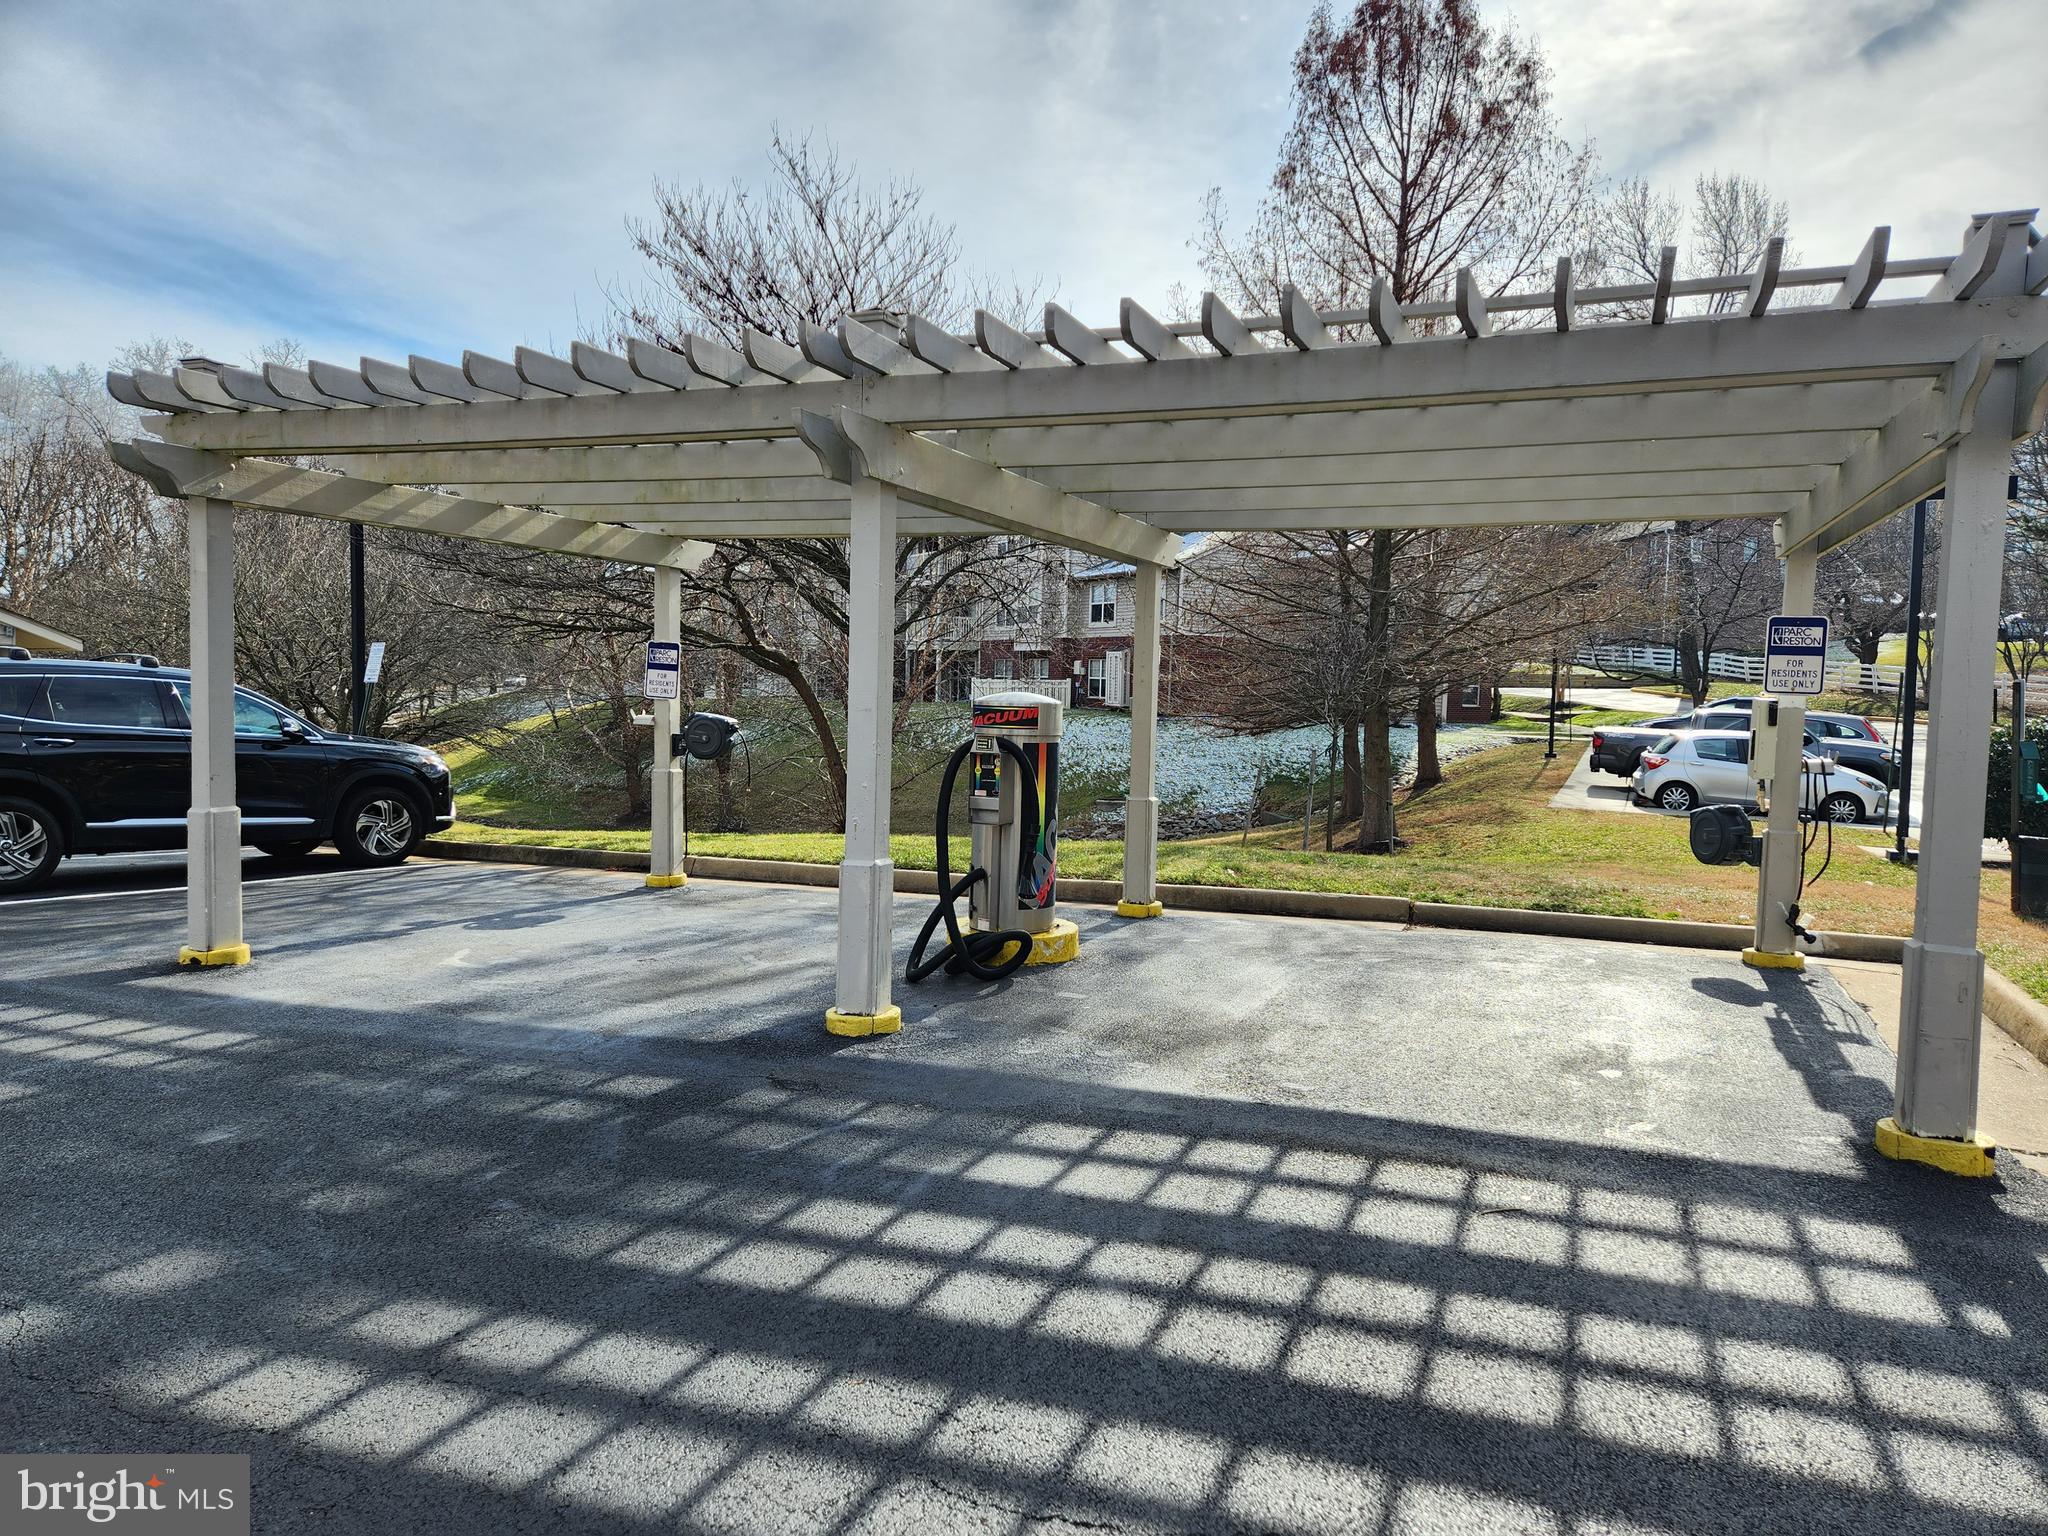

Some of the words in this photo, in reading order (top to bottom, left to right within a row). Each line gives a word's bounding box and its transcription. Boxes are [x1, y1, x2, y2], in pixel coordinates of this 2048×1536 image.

[1784, 627, 1812, 637] PARC
[1783, 636, 1821, 646] RESTON
[1786, 659, 1804, 668] FOR
[1771, 669, 1818, 678] RESIDENTS
[1772, 679, 1789, 688] USE
[1792, 680, 1815, 689] ONLY
[973, 707, 1039, 726] VACUUM
